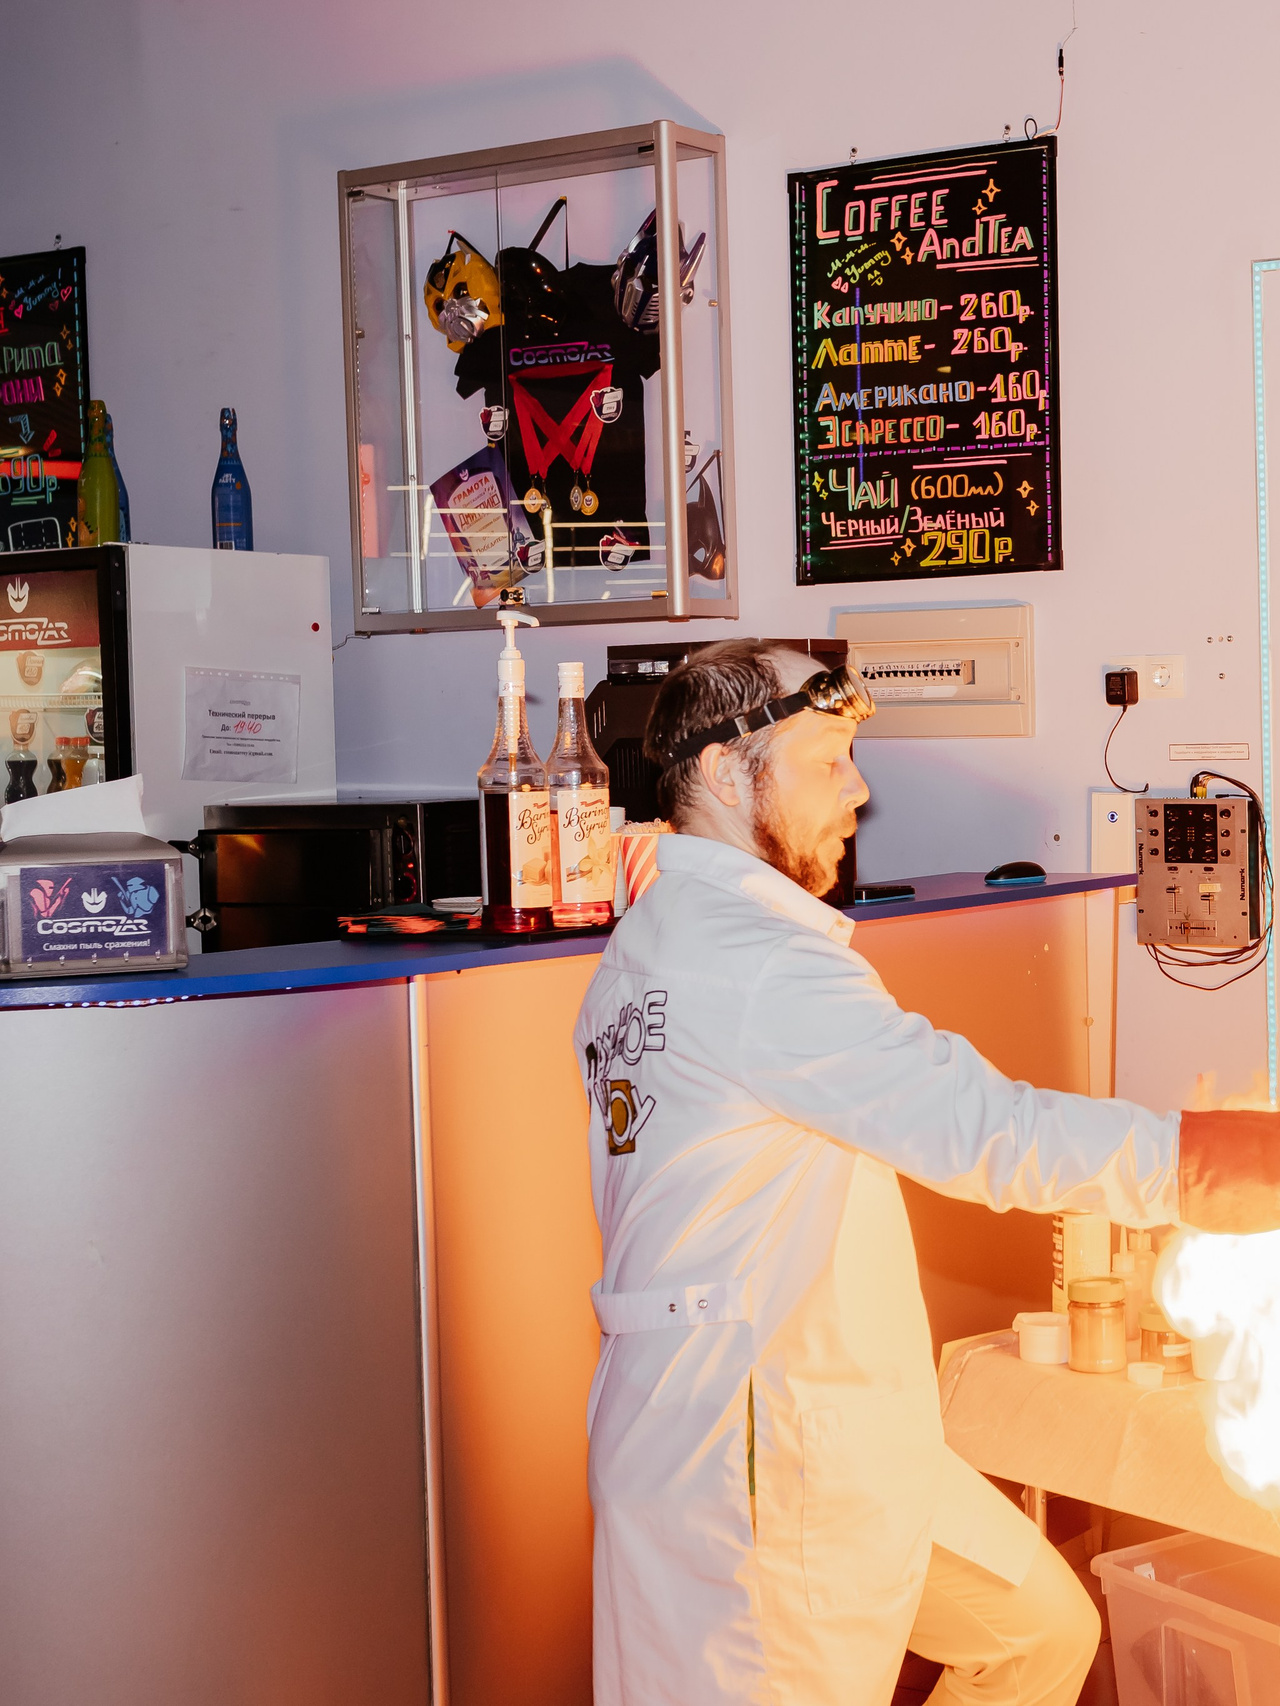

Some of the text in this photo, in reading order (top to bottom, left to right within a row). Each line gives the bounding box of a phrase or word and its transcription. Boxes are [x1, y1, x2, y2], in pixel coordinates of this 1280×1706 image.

[844, 250, 892, 284] Yummy
[0, 341, 64, 374] рита
[453, 475, 490, 505] ГРАМОТА
[208, 709, 276, 721] Технический перерыв
[221, 723, 231, 732] До:
[574, 819, 608, 842] Syrup
[43, 939, 151, 951] Смахни пыль сражения!
